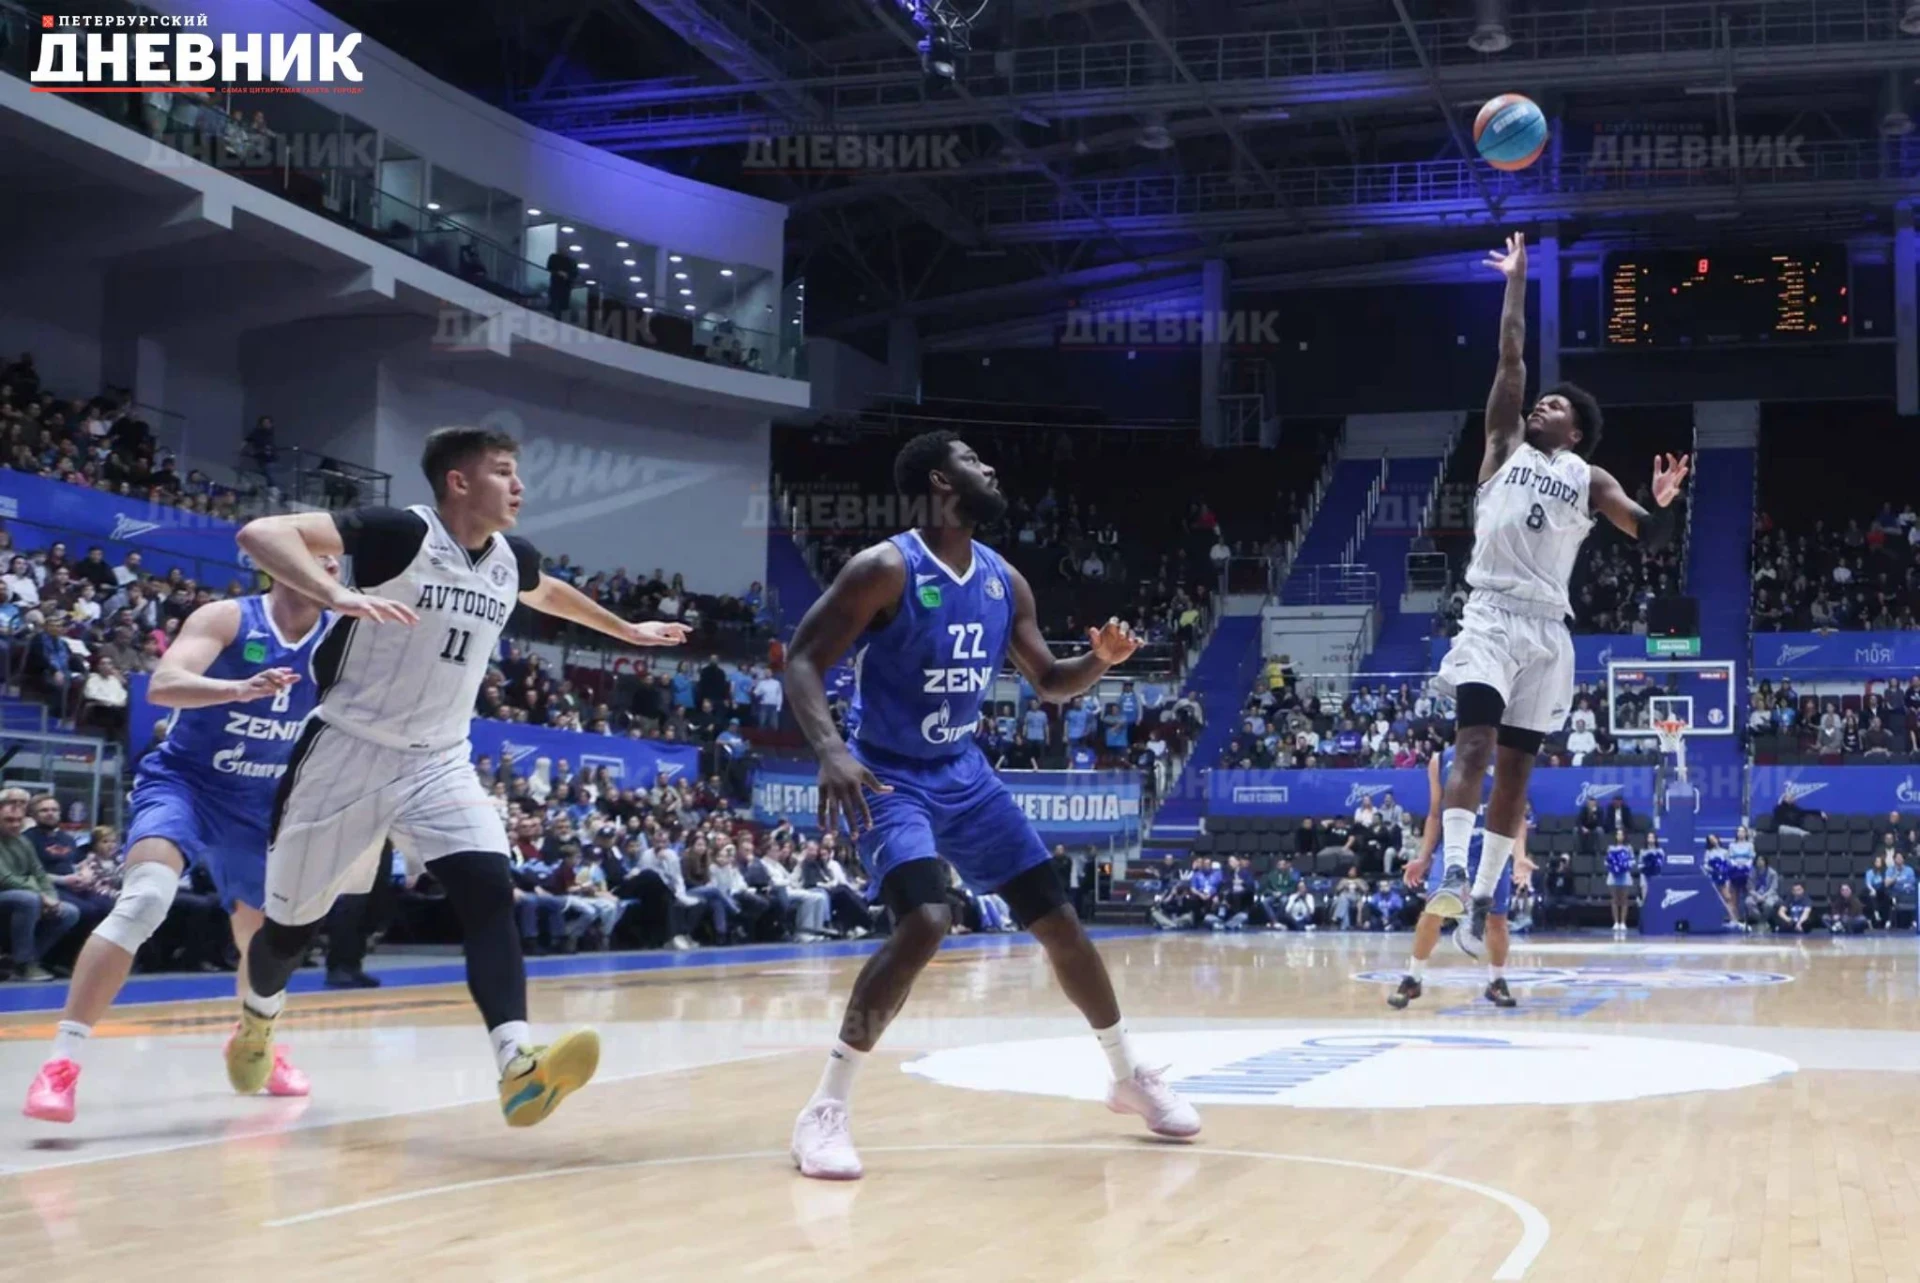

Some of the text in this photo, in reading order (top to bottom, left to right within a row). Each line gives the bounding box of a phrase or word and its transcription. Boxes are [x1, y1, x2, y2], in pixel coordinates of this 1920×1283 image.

[1526, 503, 1545, 529] 8
[440, 628, 471, 662] 11
[948, 622, 987, 660] 22
